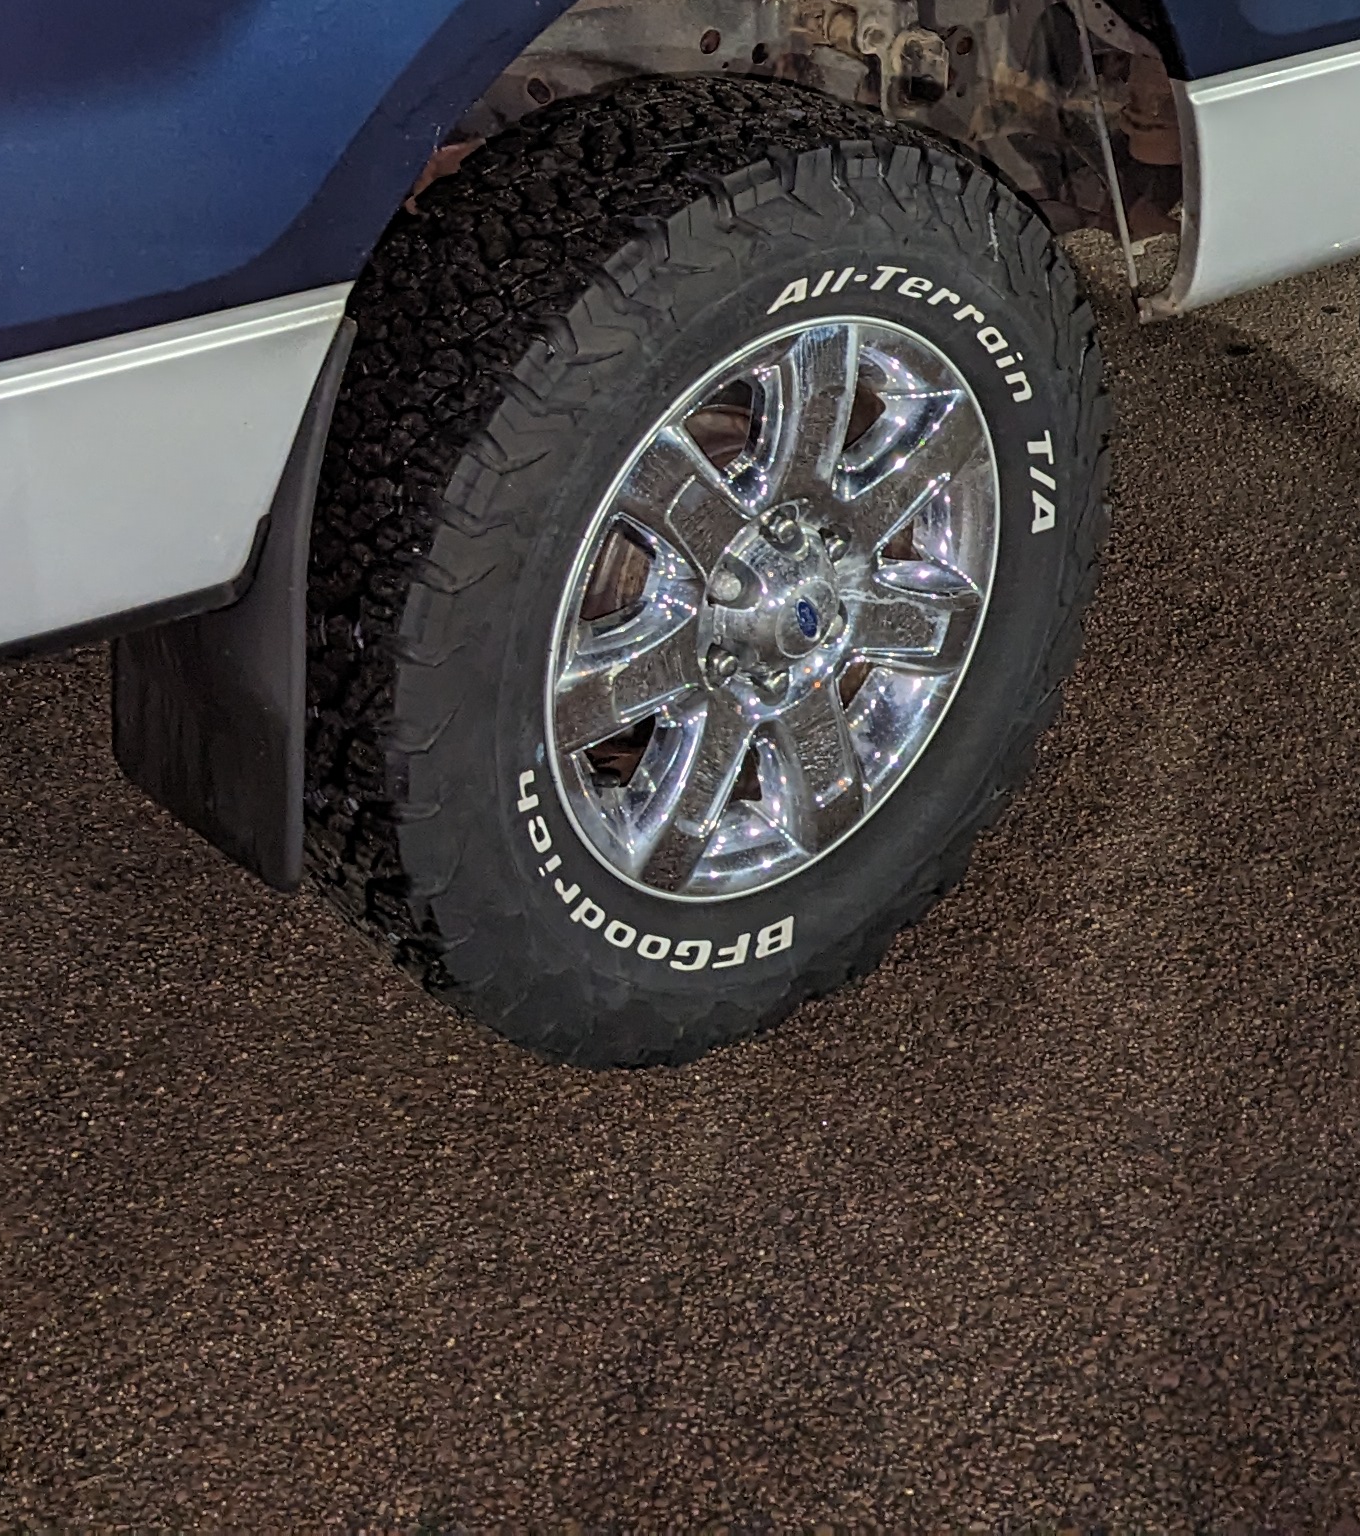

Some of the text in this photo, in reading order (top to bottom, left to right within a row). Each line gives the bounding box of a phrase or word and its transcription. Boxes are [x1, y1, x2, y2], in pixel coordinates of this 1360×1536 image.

[767, 265, 1057, 534] All-Terrain T/A
[517, 769, 794, 971] BFGoodrich
